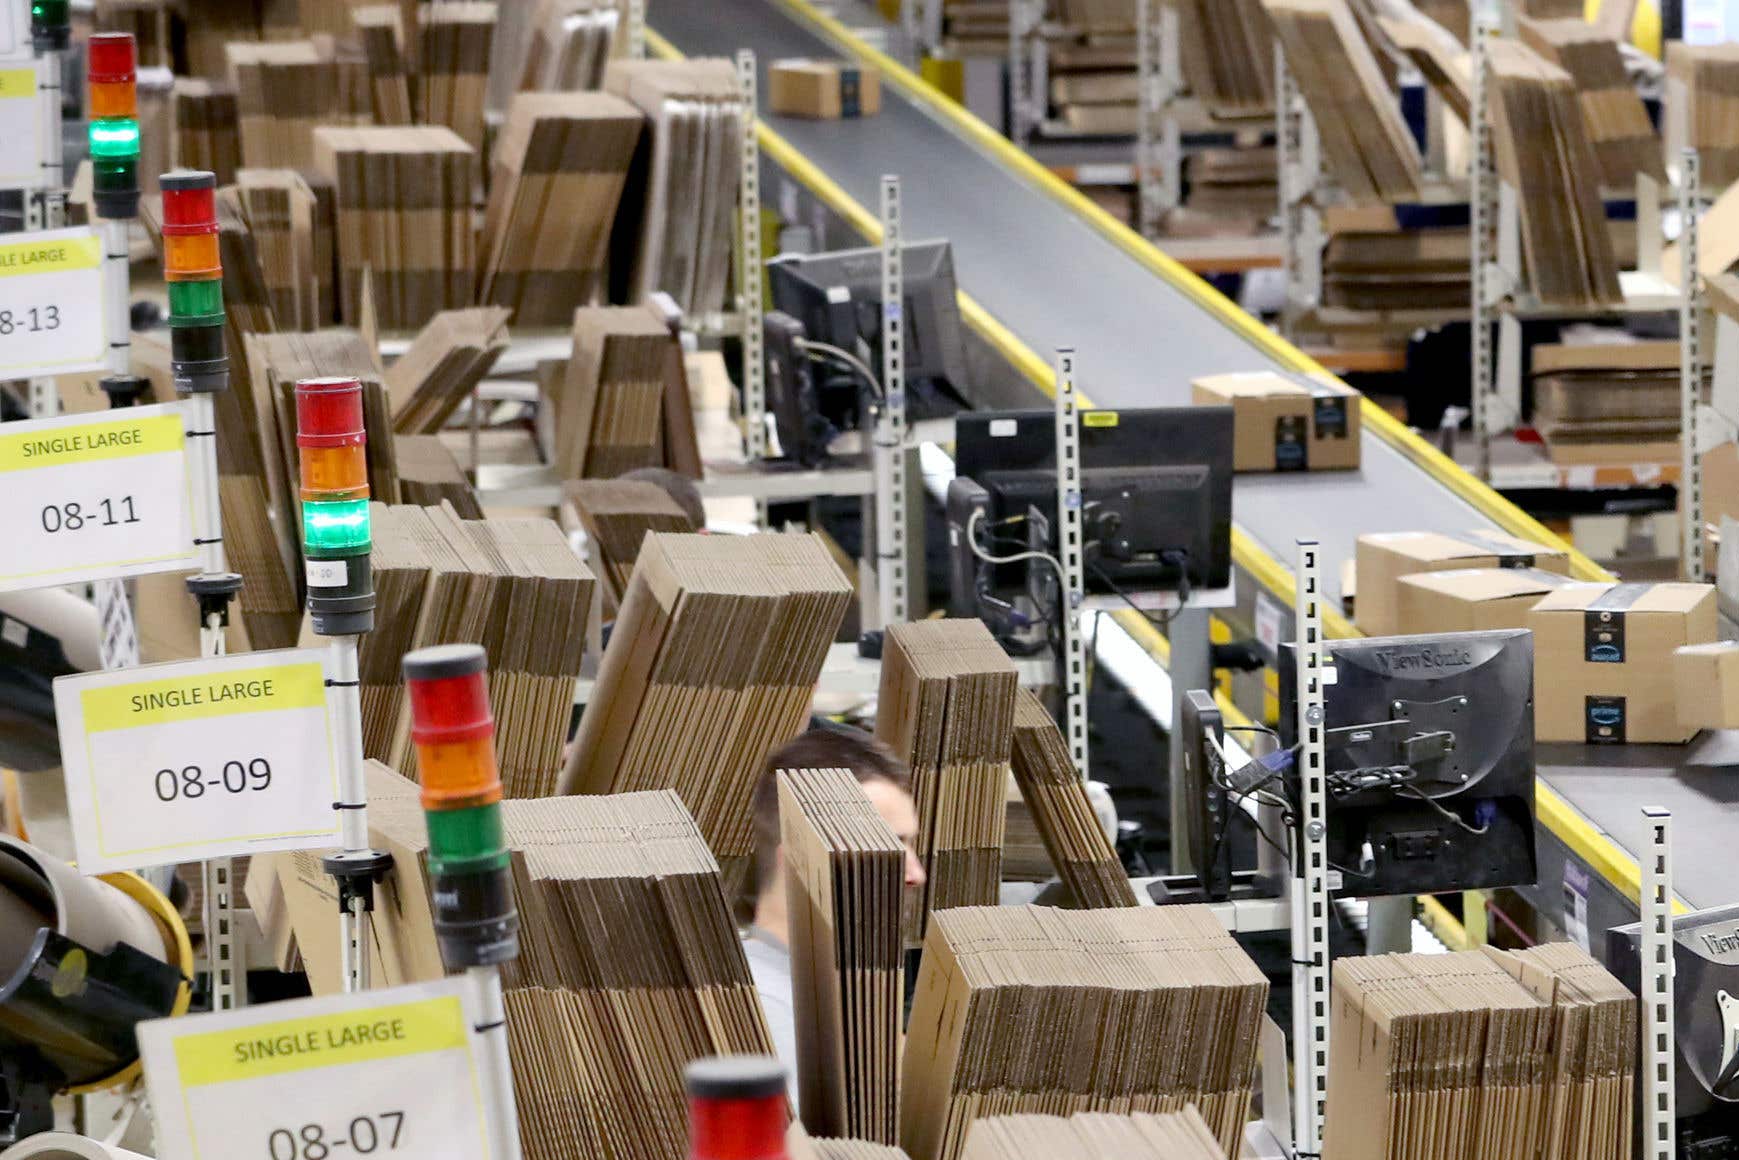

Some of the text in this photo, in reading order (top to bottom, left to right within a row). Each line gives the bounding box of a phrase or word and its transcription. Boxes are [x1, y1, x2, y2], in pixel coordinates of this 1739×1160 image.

[21, 248, 67, 266] LARGE
[22, 429, 143, 458] SINGLE LARGE
[41, 495, 141, 534] 08-11
[1375, 648, 1472, 674] ViewSonic
[131, 679, 275, 713] SINGLE LARGE
[155, 757, 273, 802] 08-09
[234, 1019, 406, 1064] SINGLE LARGE
